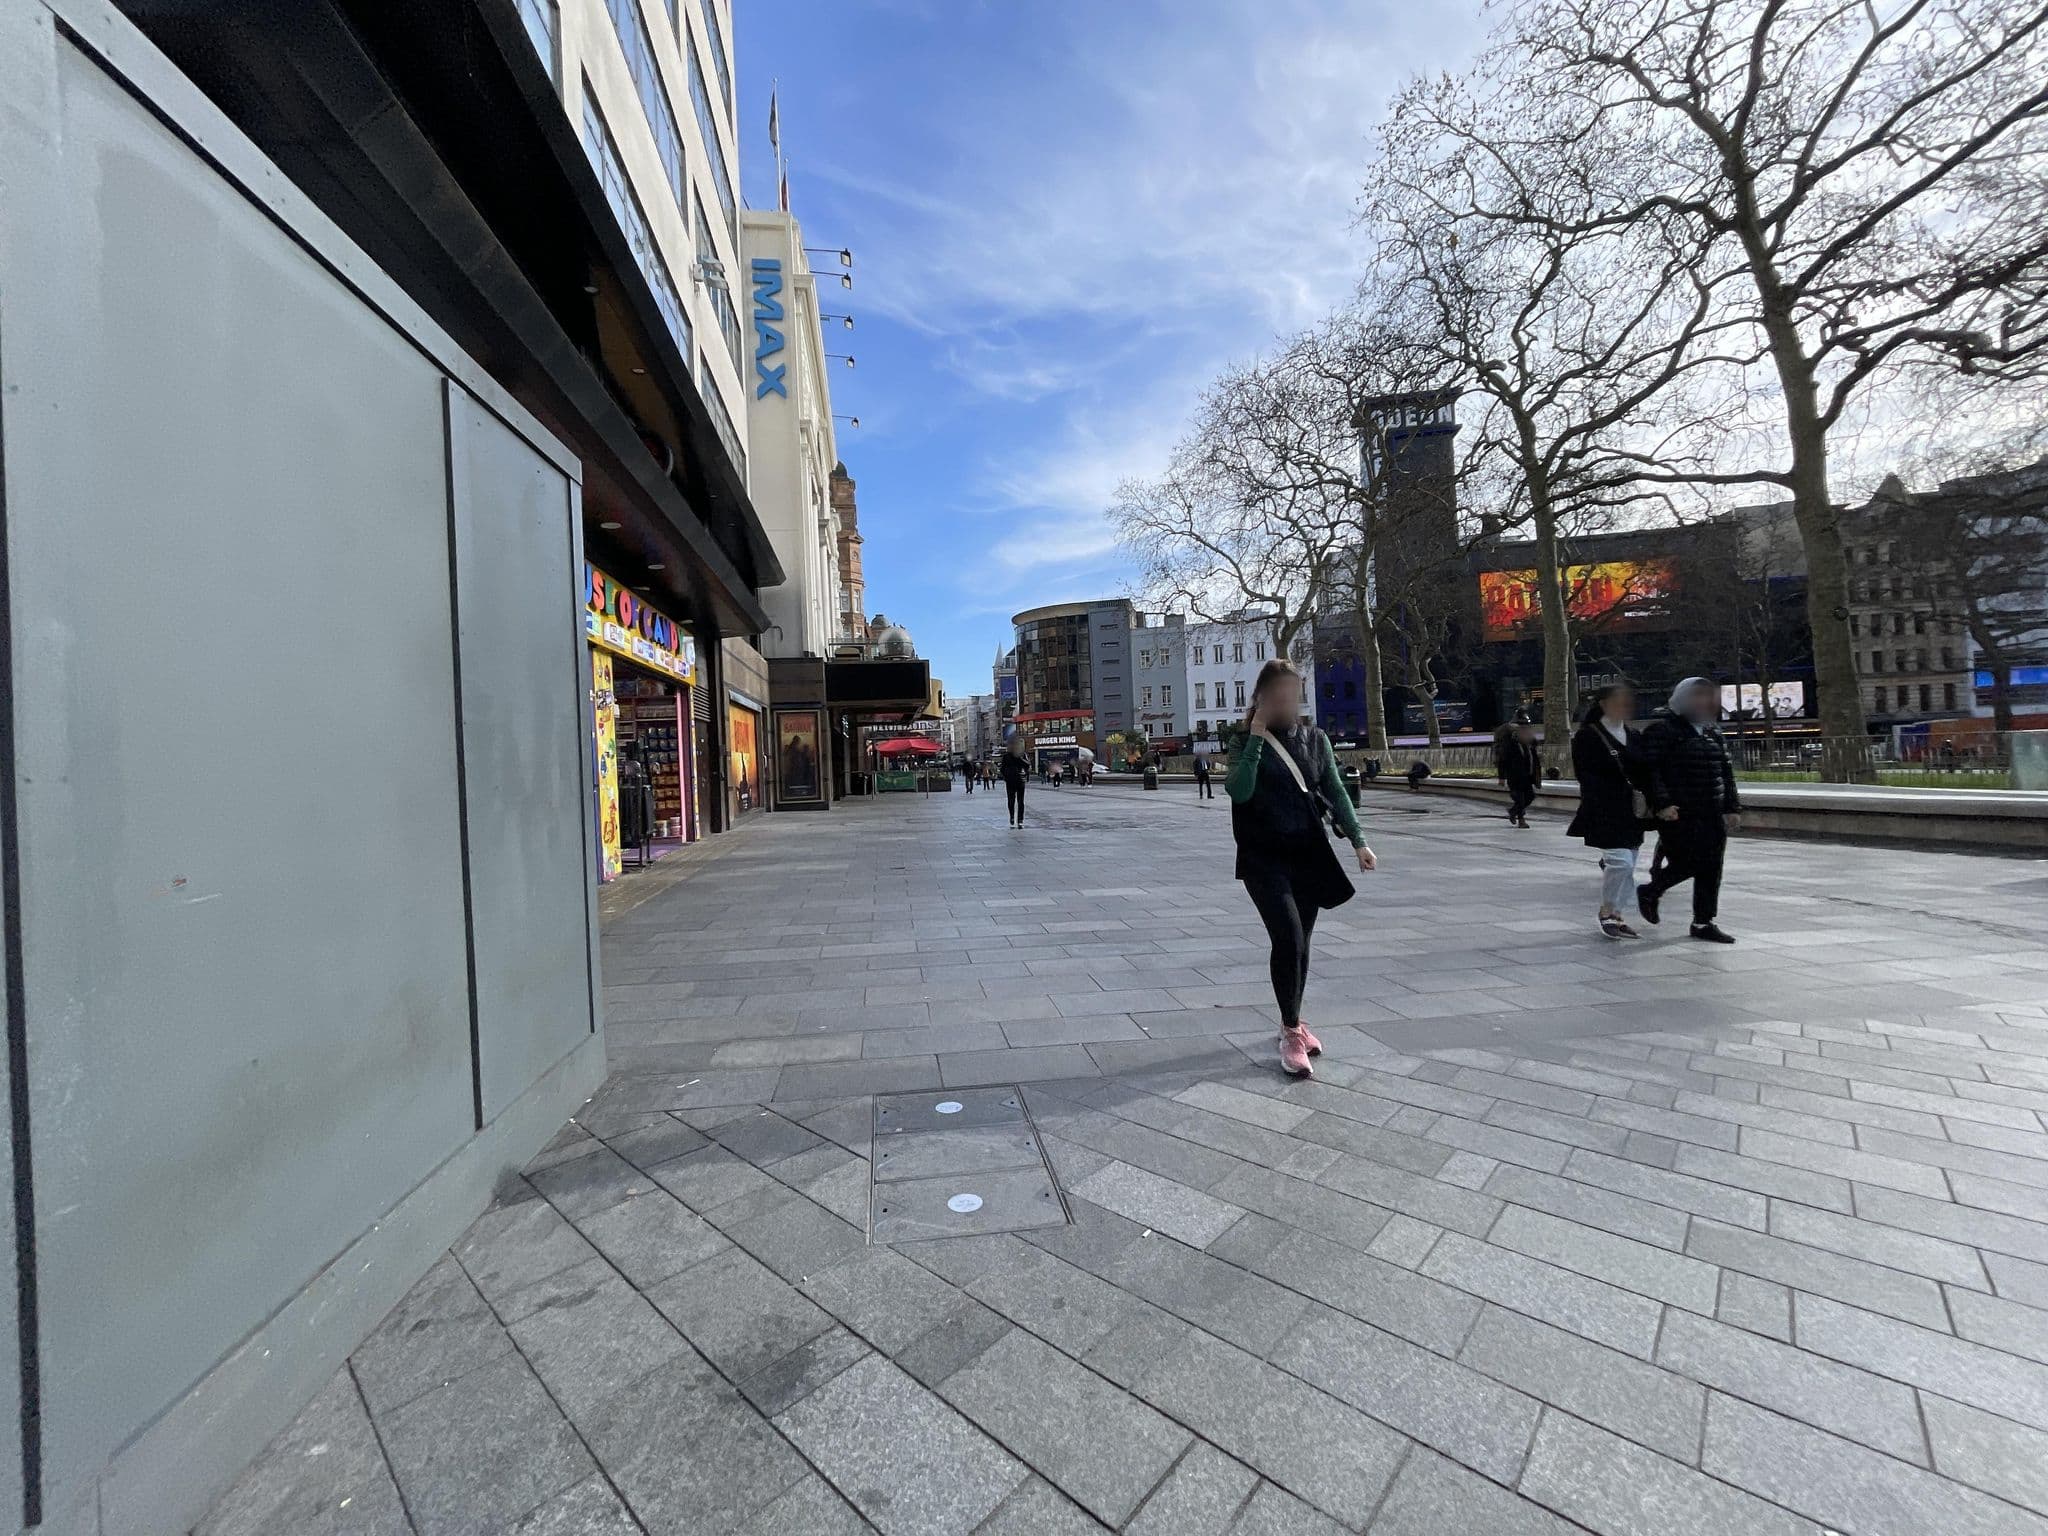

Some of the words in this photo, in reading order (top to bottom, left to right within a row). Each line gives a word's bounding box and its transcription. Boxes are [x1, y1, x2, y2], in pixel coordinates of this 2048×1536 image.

[751, 258, 787, 401] IMAX
[619, 591, 640, 629] OF
[1034, 737, 1058, 746] BURGER
[1059, 735, 1077, 744] KING
